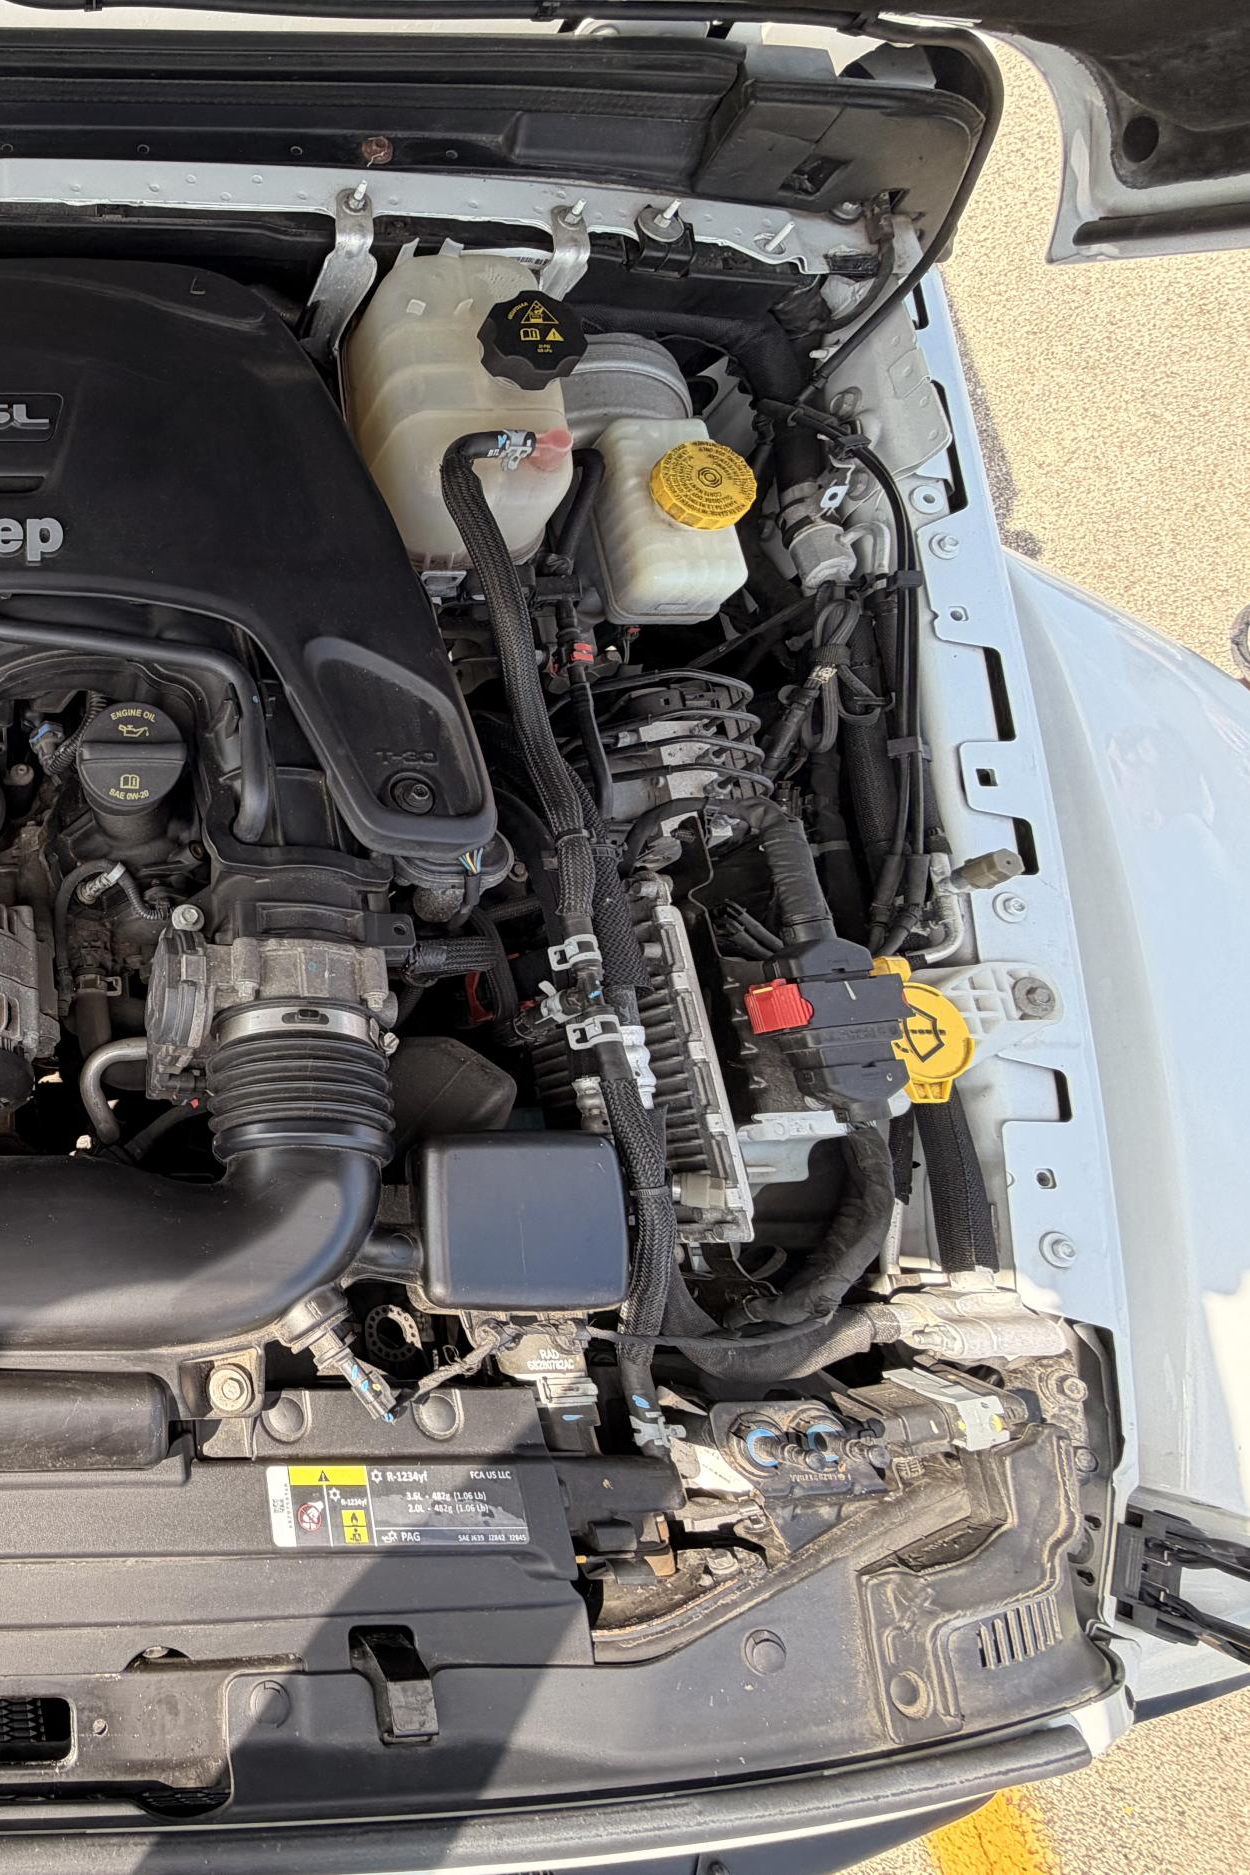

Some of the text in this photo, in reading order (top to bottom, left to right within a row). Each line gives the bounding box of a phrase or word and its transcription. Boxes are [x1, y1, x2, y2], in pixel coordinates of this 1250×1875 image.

[110, 708, 156, 723] ENGINE OIL
[109, 788, 149, 800] SAE 0W-20
[539, 1349, 560, 1360] RAD
[386, 1470, 511, 1483] R-1234yf FCA US LLC
[401, 1532, 421, 1542] PAG
